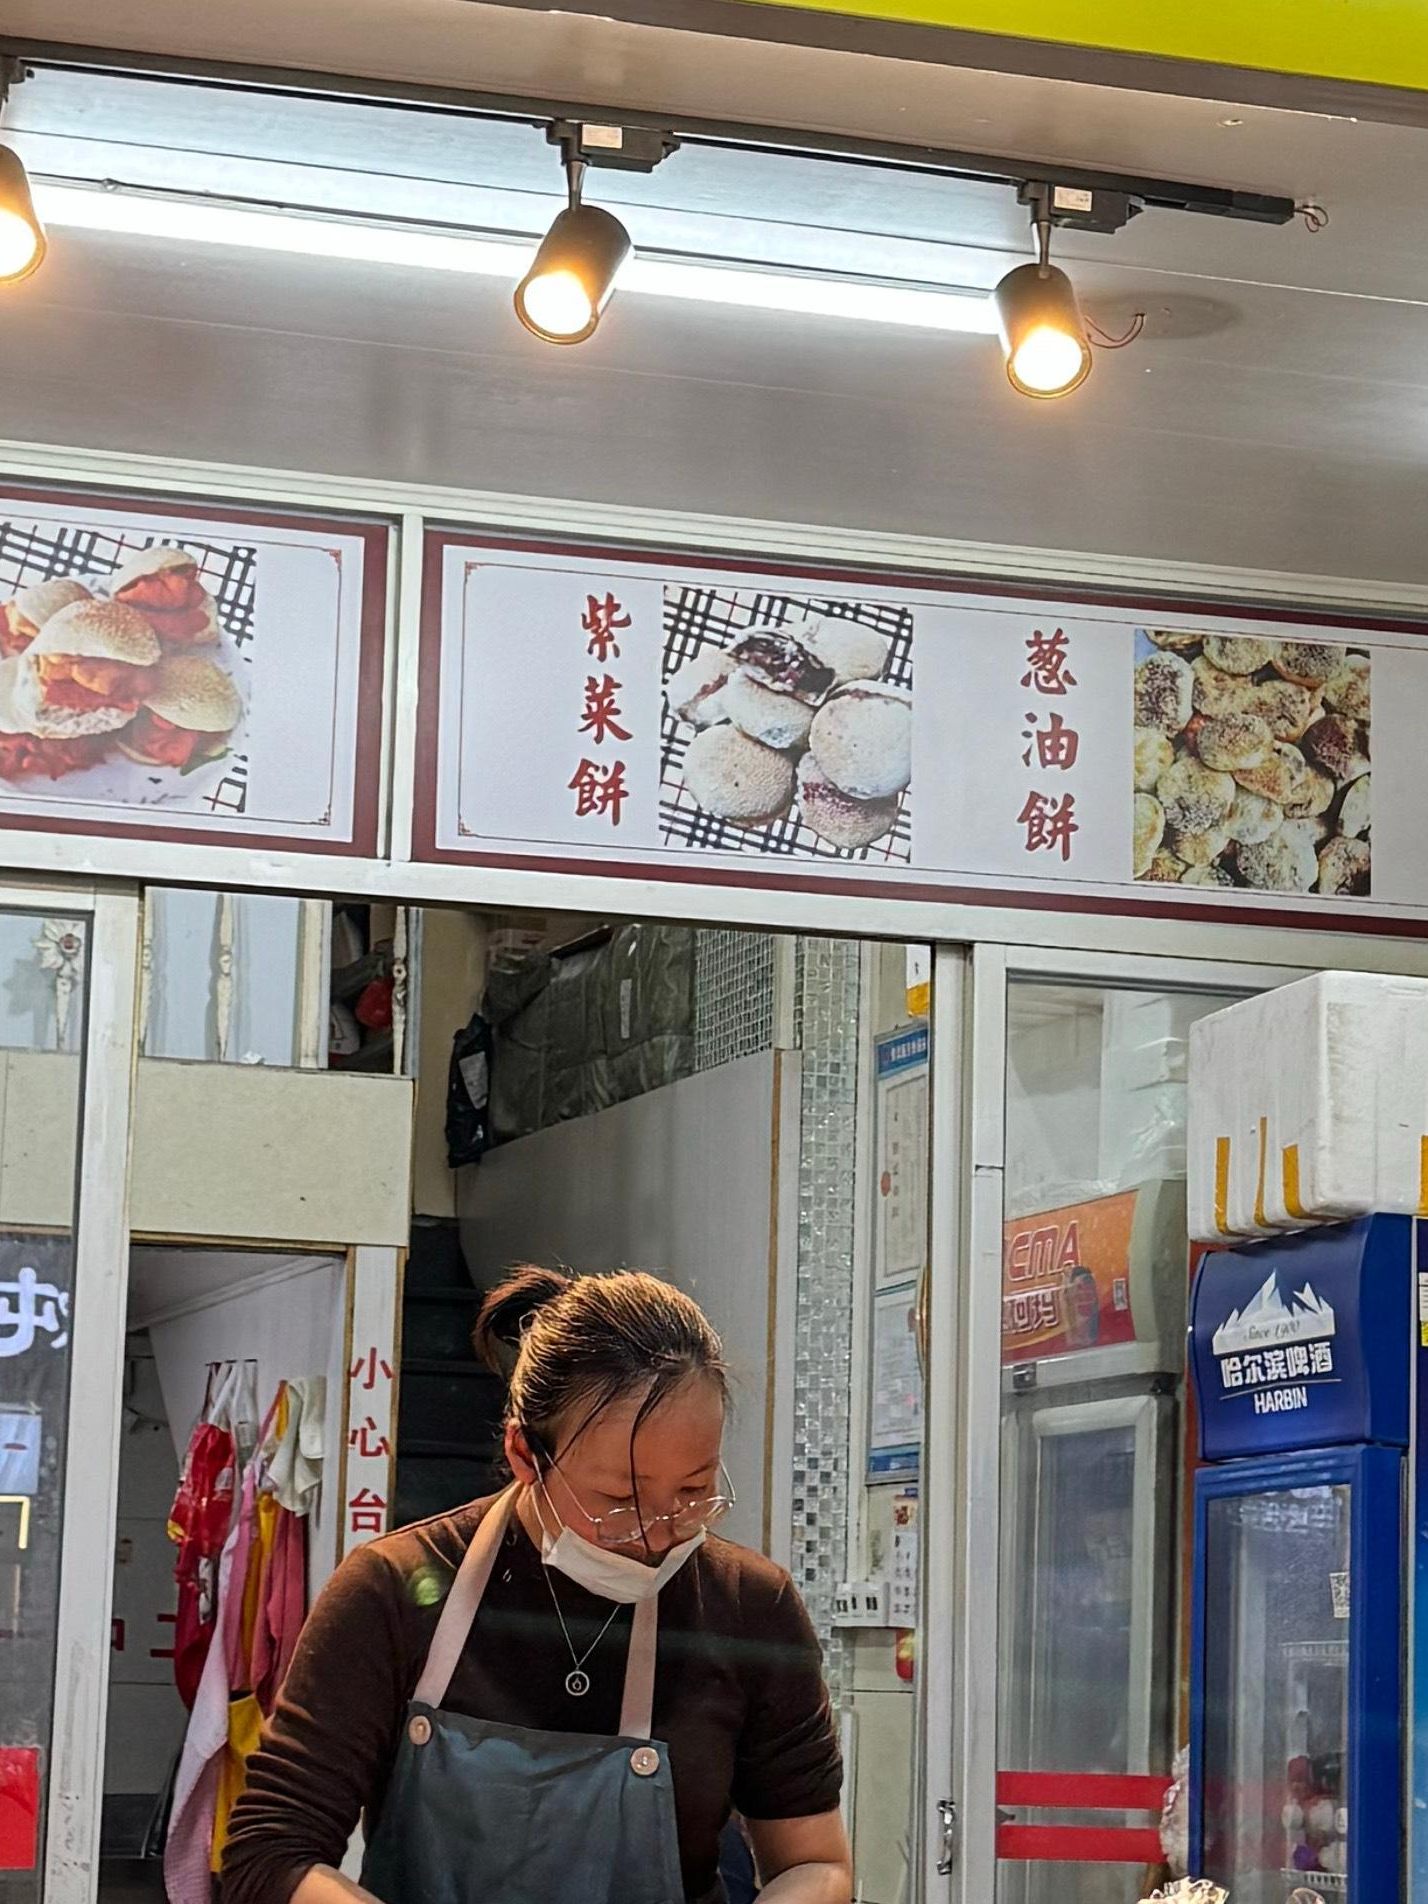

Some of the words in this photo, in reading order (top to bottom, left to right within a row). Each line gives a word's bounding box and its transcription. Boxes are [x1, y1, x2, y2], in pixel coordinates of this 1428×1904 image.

[569, 591, 634, 828] 紫菜餅
[1016, 627, 1079, 864] 葱油餅
[349, 1347, 395, 1533] 小心台
[1220, 1341, 1334, 1389] 哈尔滨啤酒
[1253, 1386, 1309, 1415] HARBIN
